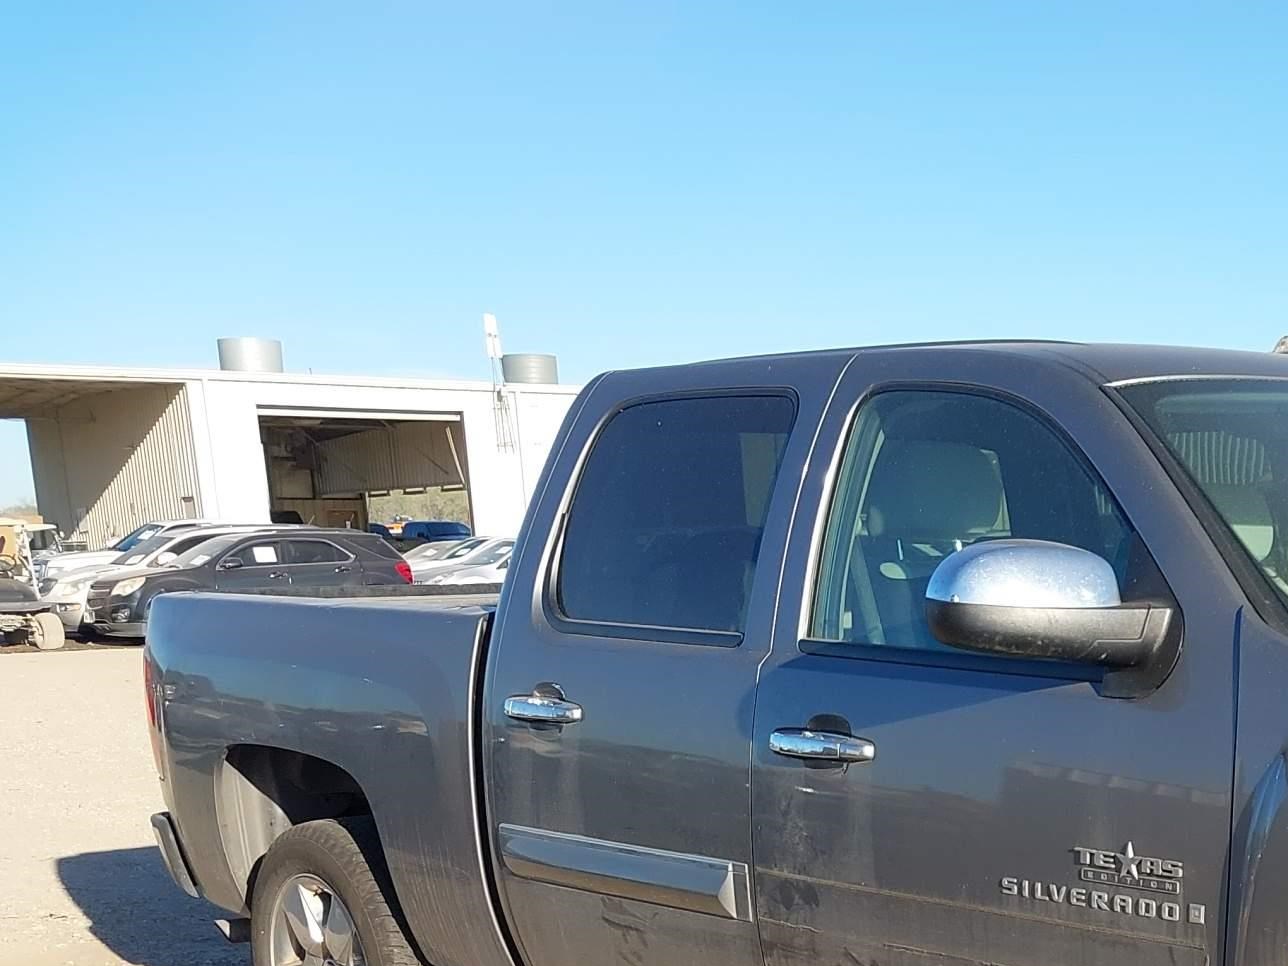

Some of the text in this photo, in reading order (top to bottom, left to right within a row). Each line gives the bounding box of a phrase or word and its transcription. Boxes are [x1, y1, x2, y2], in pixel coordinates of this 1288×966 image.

[1072, 841, 1184, 879] TEXAS
[1000, 876, 1181, 922] SILVERADO
[1087, 870, 1174, 891] EDITION
